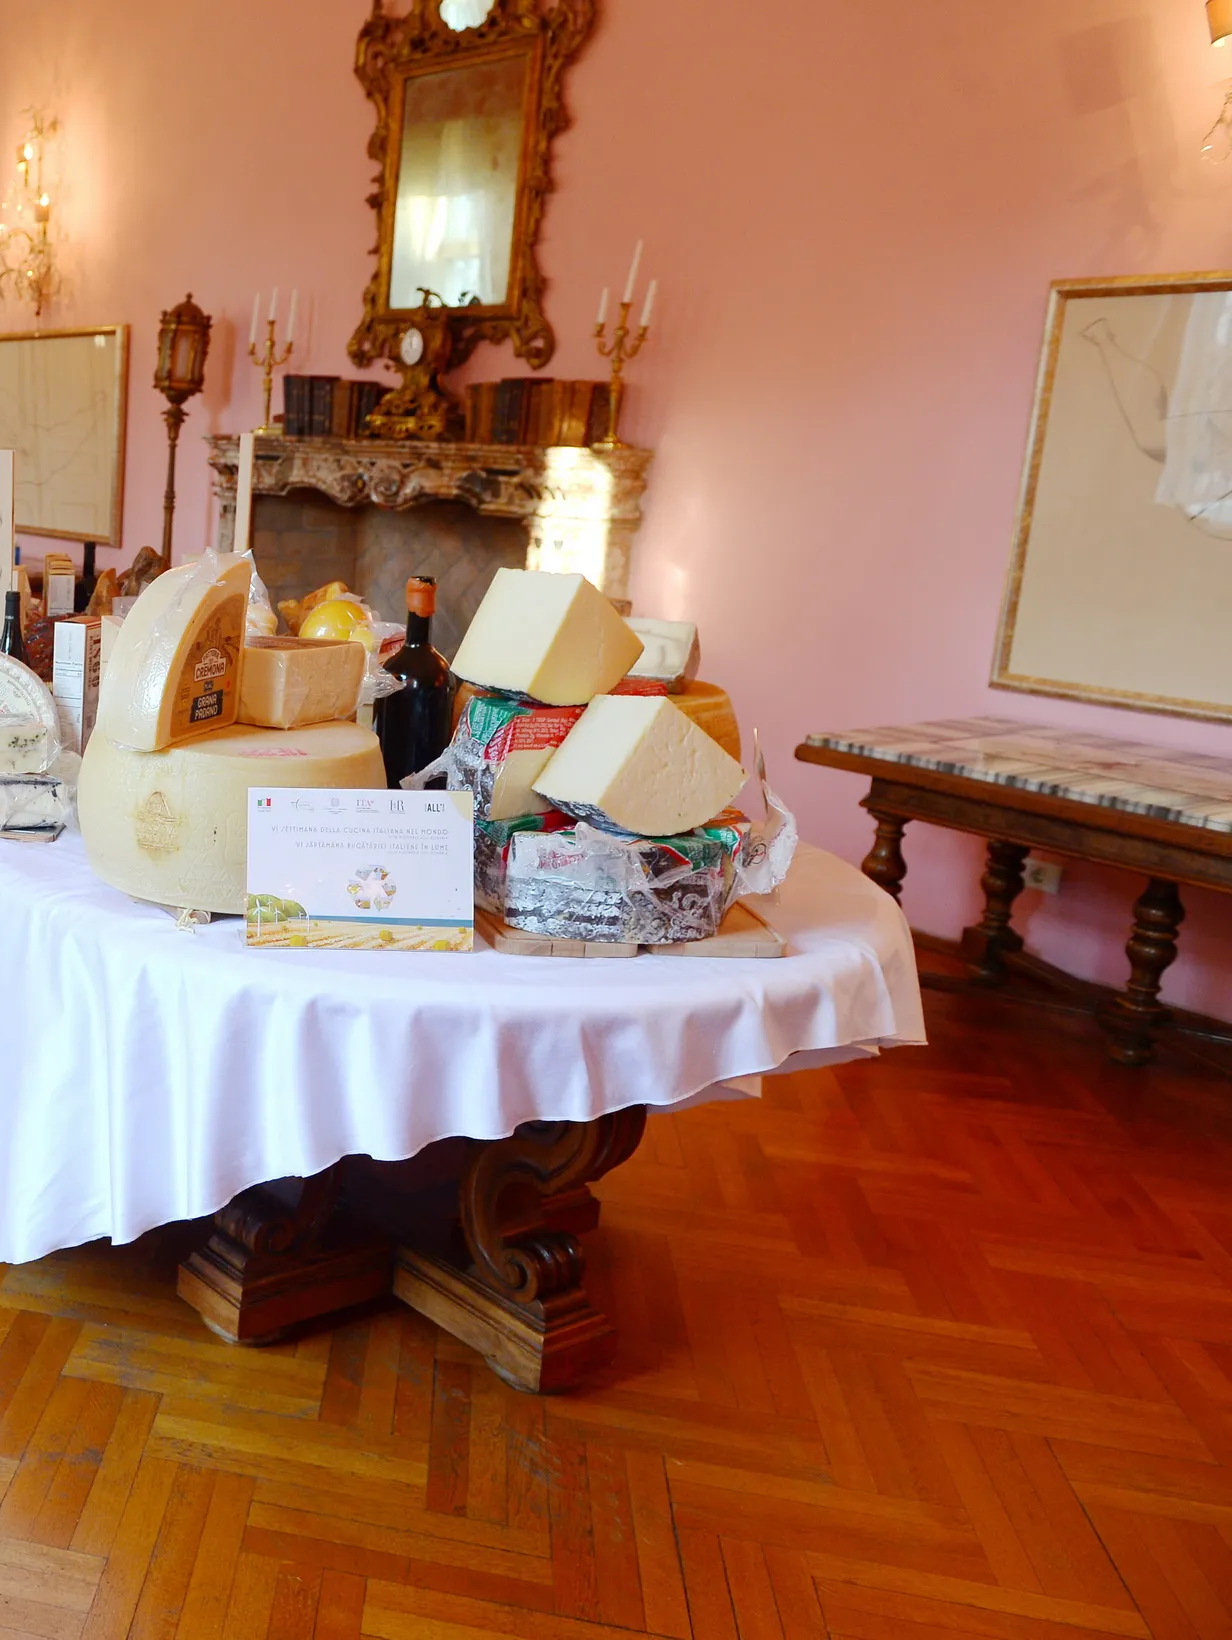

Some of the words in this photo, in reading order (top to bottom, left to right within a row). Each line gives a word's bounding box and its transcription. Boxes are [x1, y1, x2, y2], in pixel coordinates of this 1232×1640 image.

[196, 662, 225, 679] CREMONA
[197, 693, 217, 708] GRANA
[194, 705, 218, 720] PADANO
[280, 825, 318, 833] SETTIMANA
[421, 828, 449, 836] MONDO
[431, 843, 448, 851] LUME
